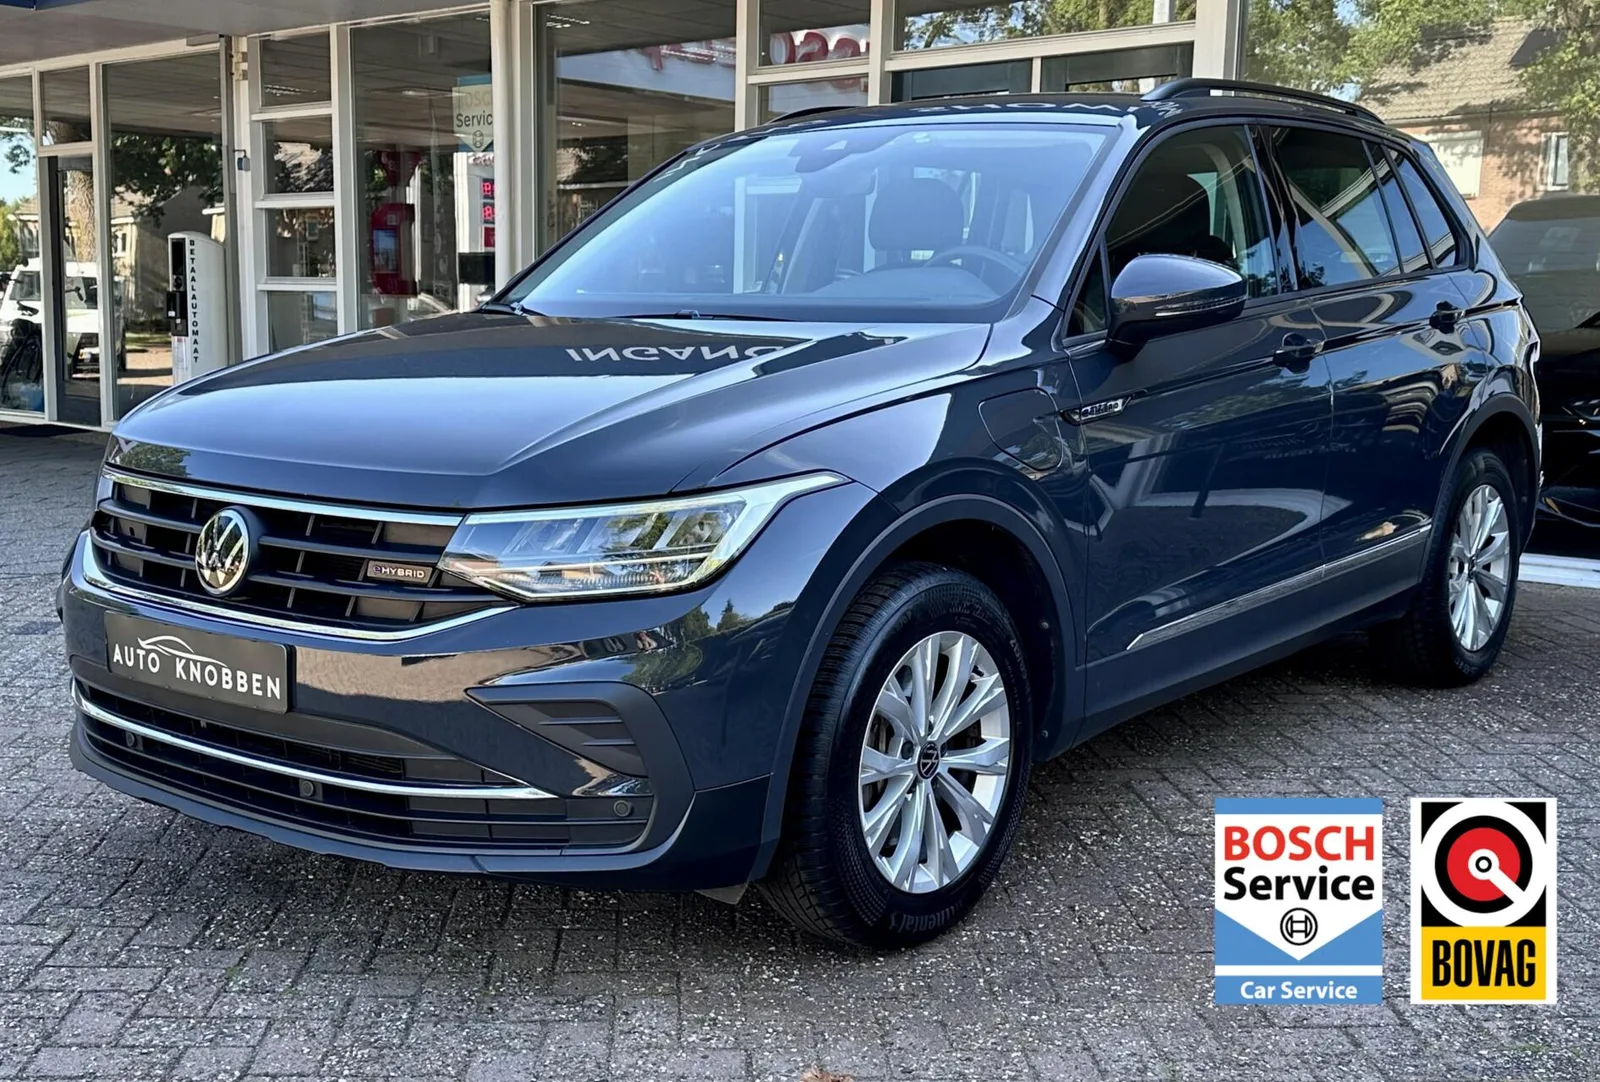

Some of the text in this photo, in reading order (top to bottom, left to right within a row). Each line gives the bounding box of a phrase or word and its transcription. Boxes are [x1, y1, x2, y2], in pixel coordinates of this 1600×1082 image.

[456, 110, 493, 128] Servic
[189, 239, 199, 363] BETAALAUTOMAAT
[113, 643, 281, 700] AUTO KNOBBEN
